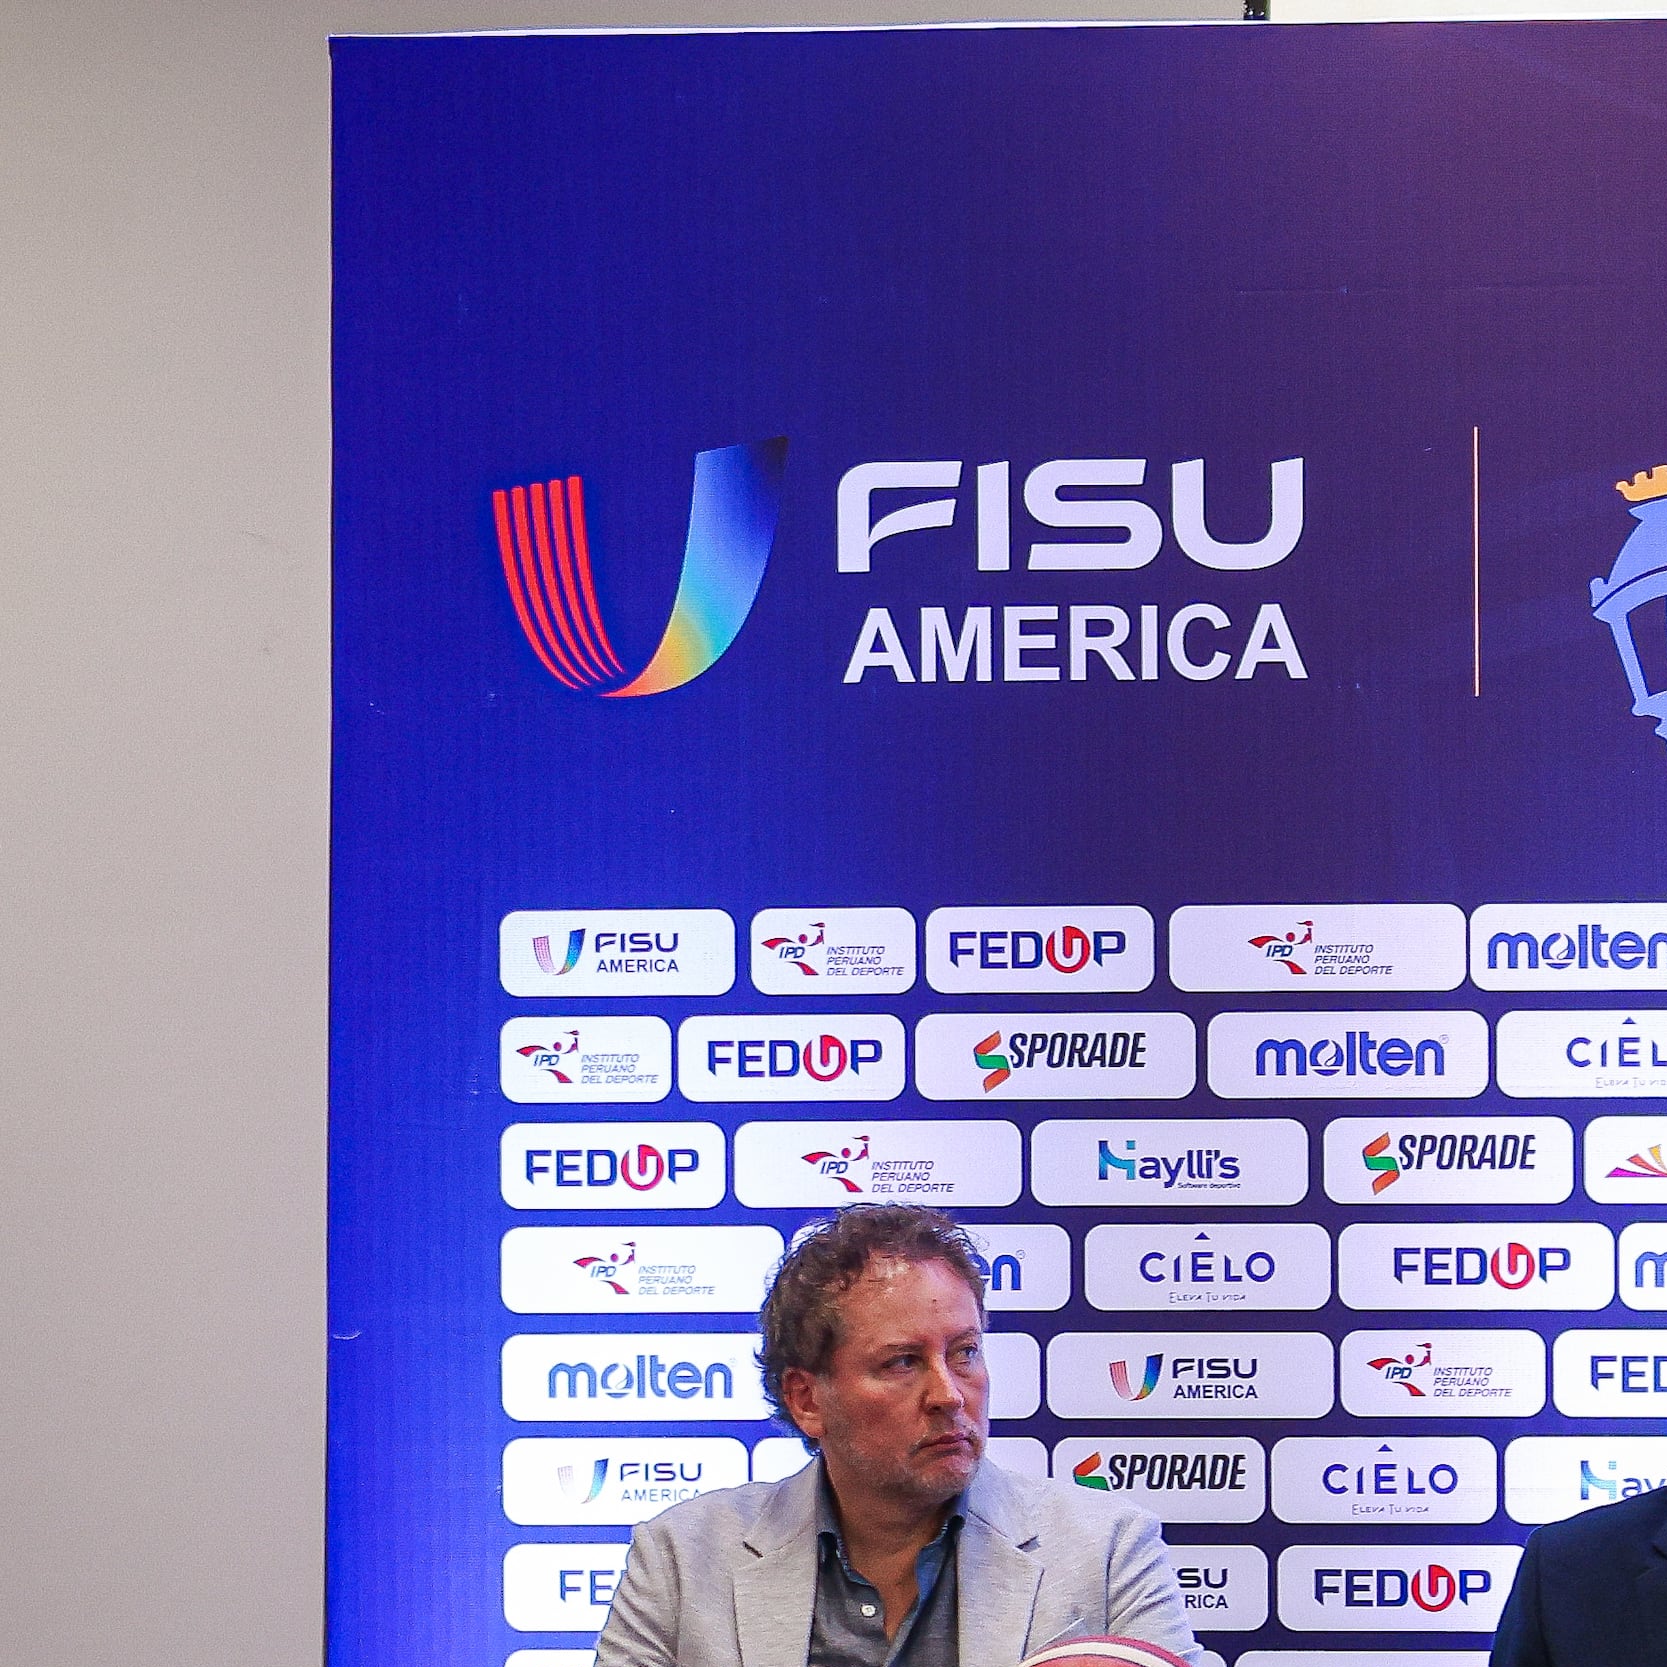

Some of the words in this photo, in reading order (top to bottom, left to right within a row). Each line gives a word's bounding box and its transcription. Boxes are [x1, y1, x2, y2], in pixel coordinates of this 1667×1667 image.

[837, 457, 1303, 574] FISU
[843, 605, 1307, 684] AMERICA
[595, 933, 678, 953] FISU
[1314, 944, 1374, 954] INSTITUTO
[597, 959, 678, 972] AMERICA
[1009, 1033, 1146, 1068] SPORADE
[1256, 1031, 1444, 1076] molten
[872, 1161, 934, 1170] INSTITUTO
[1399, 1135, 1536, 1170] SPORADE
[548, 1355, 733, 1399] molten
[1172, 1358, 1257, 1379] FISU
[1173, 1385, 1258, 1398] AMERICA
[620, 1463, 701, 1481] FISU
[1109, 1455, 1246, 1490] SPORADE
